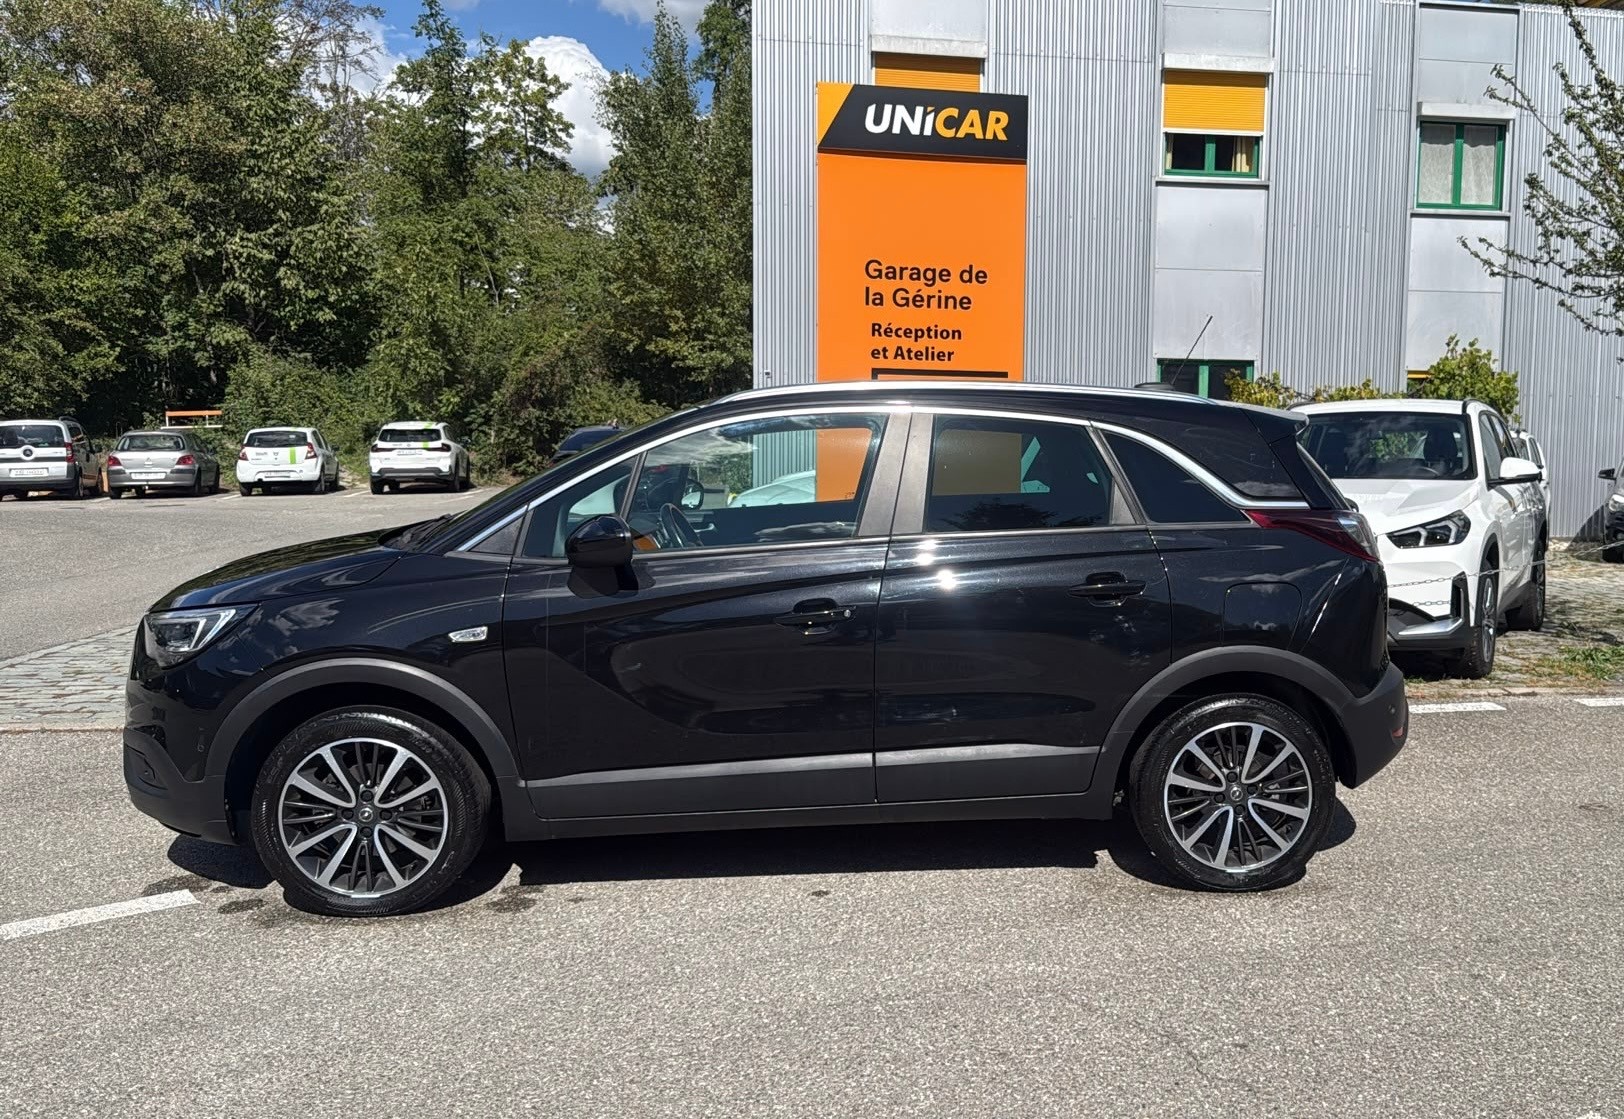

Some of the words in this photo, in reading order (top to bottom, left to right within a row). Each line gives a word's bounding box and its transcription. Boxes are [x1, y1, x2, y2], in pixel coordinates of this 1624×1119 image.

[864, 259, 952, 288] Garage
[959, 264, 988, 284] de
[865, 287, 884, 307] la
[892, 288, 973, 311] Gérine
[871, 323, 963, 342] Réception
[871, 346, 889, 360] et
[893, 346, 955, 362] Atelier
